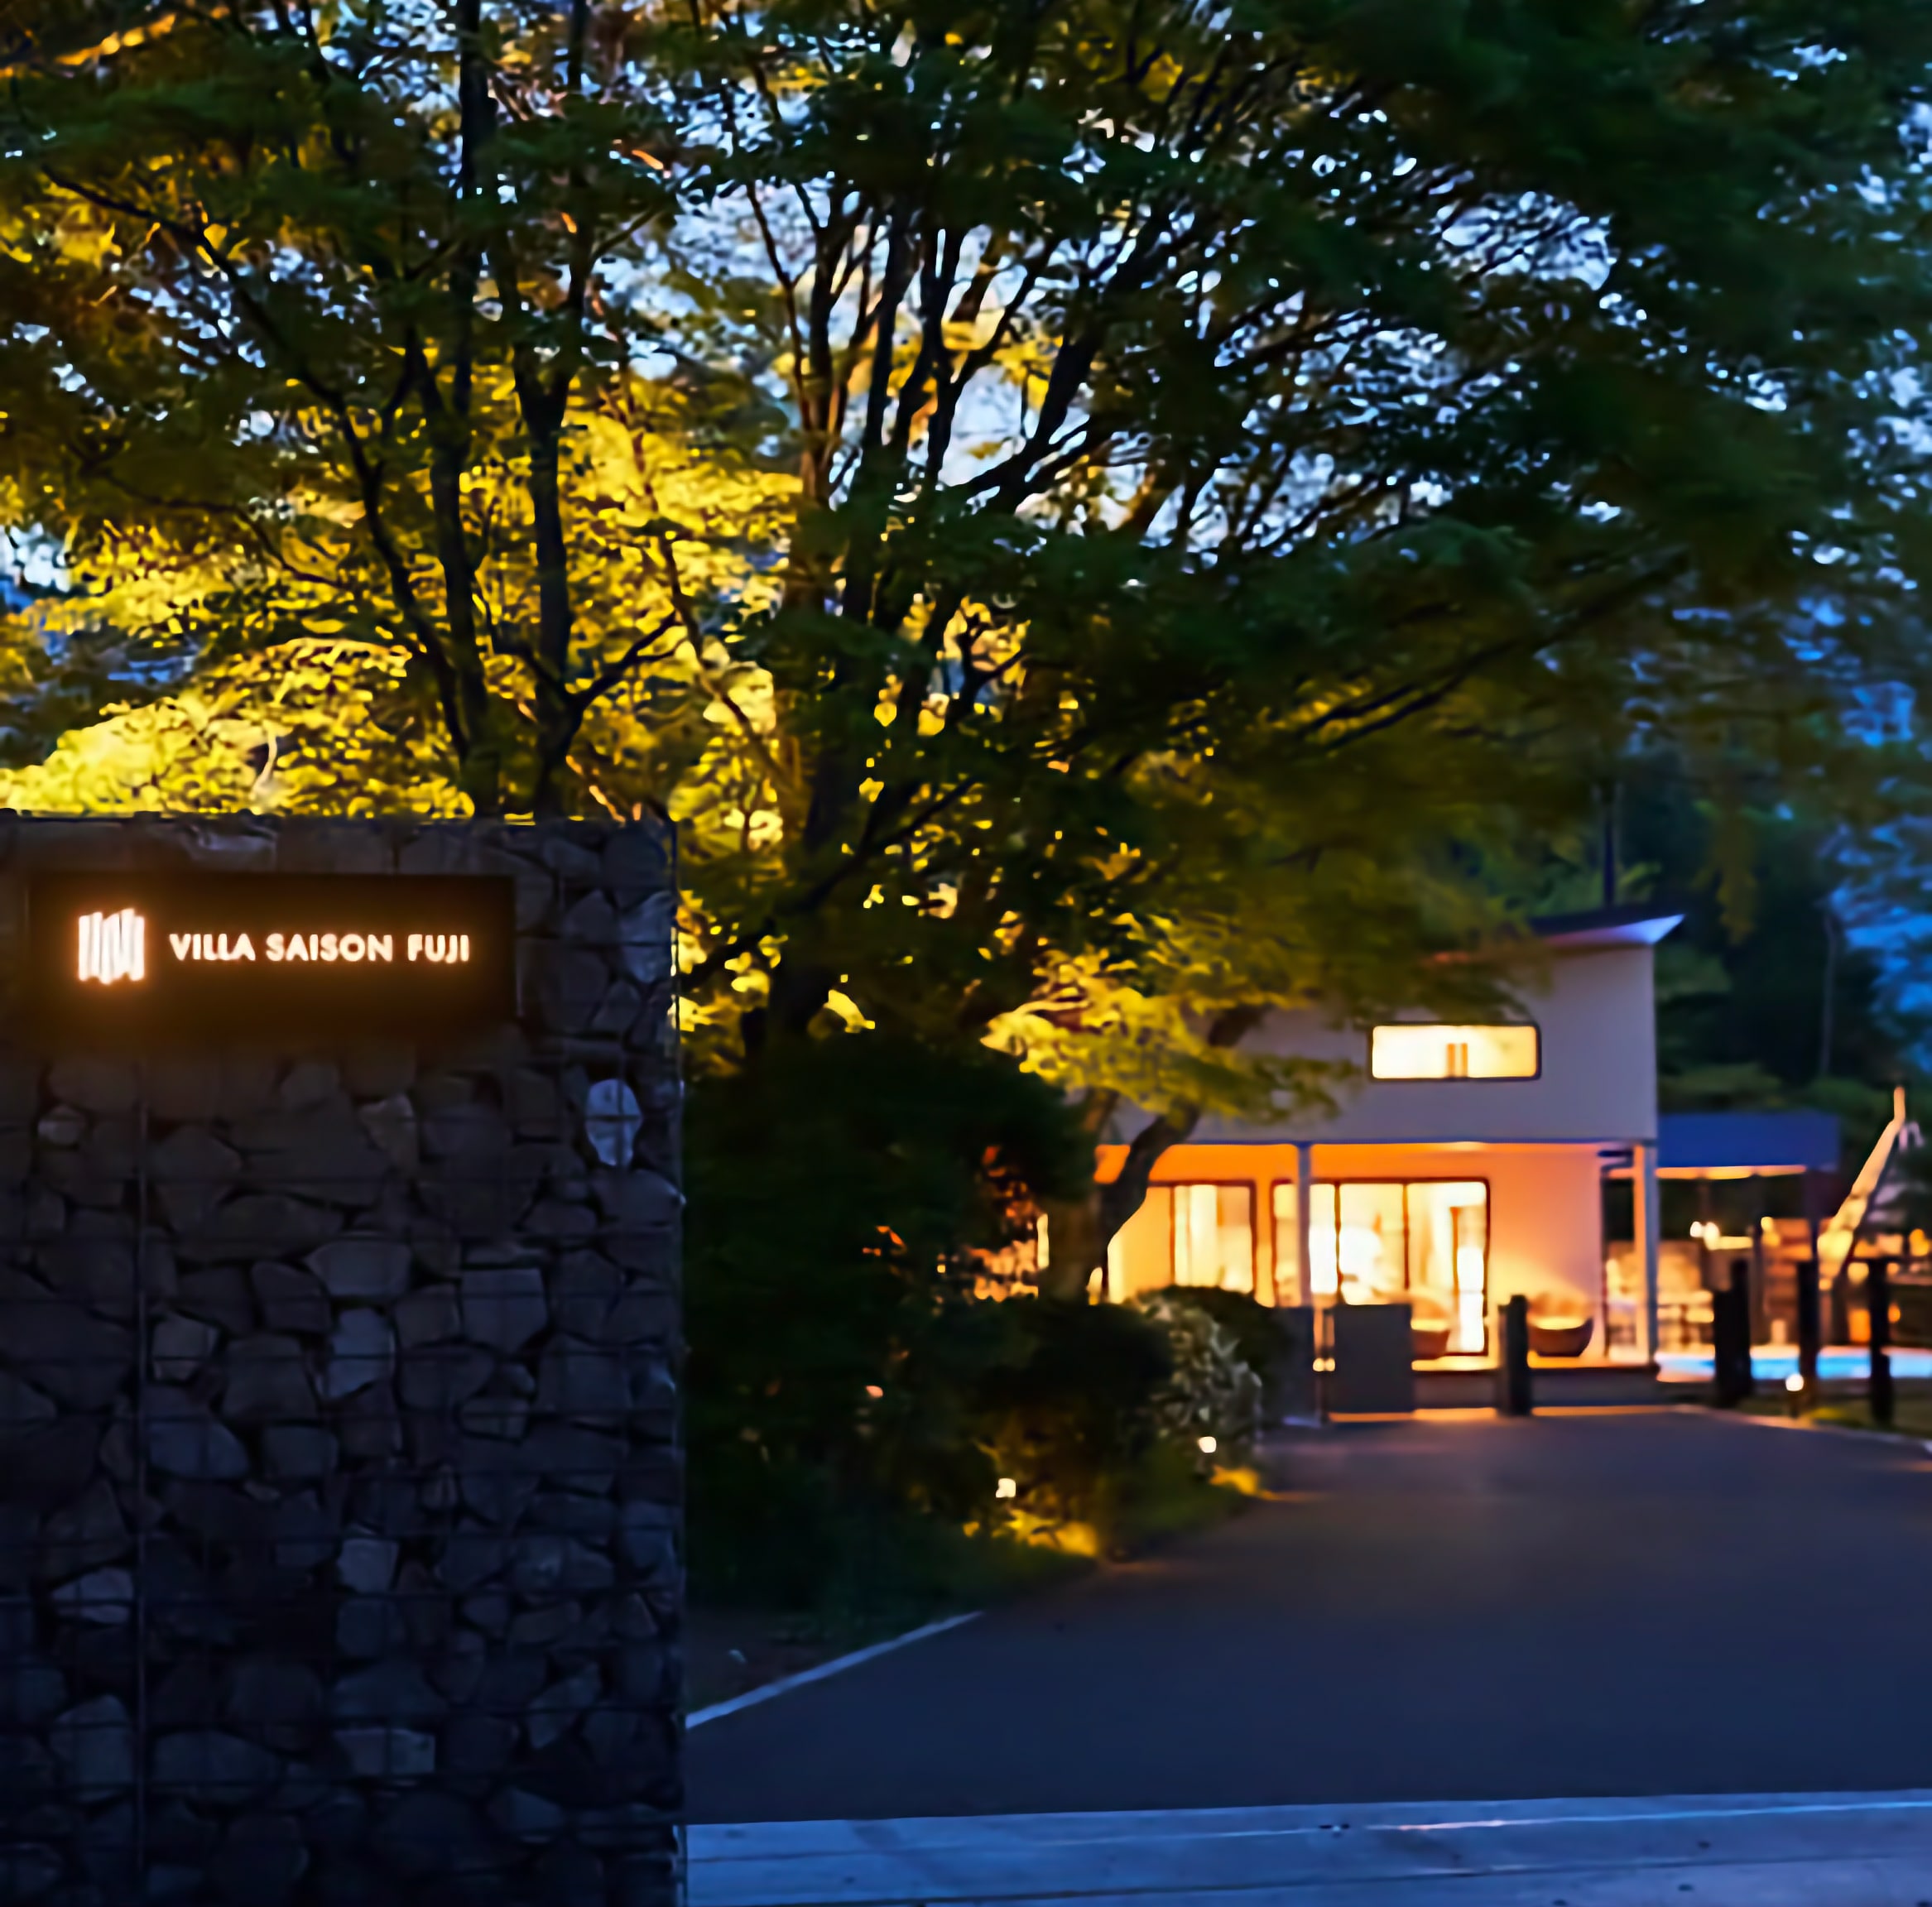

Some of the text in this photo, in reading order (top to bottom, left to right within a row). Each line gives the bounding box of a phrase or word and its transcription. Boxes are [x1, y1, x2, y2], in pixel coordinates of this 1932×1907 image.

[168, 932, 470, 963] VILLA SAISON FUJI
